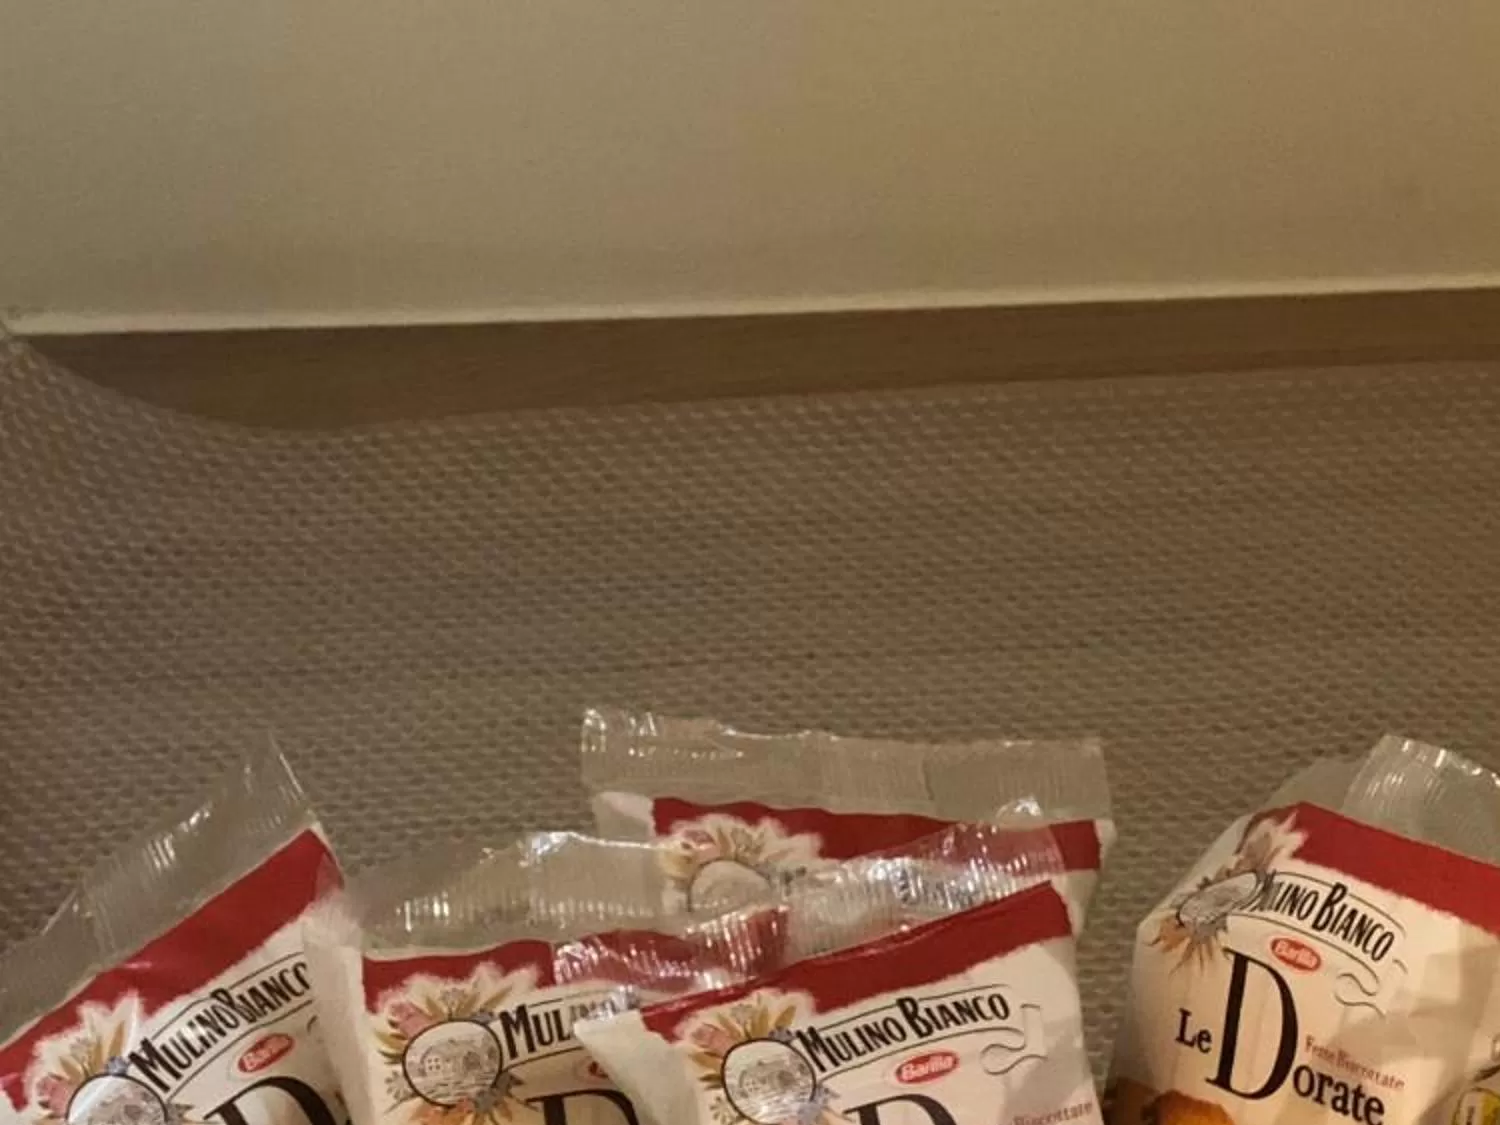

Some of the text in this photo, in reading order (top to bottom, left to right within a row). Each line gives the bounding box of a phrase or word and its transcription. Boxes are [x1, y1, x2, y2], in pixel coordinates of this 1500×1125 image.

[1311, 881, 1395, 962] BIANCO
[796, 993, 1011, 1073] MULINO BIANCO
[1175, 1008, 1212, 1054] Le
